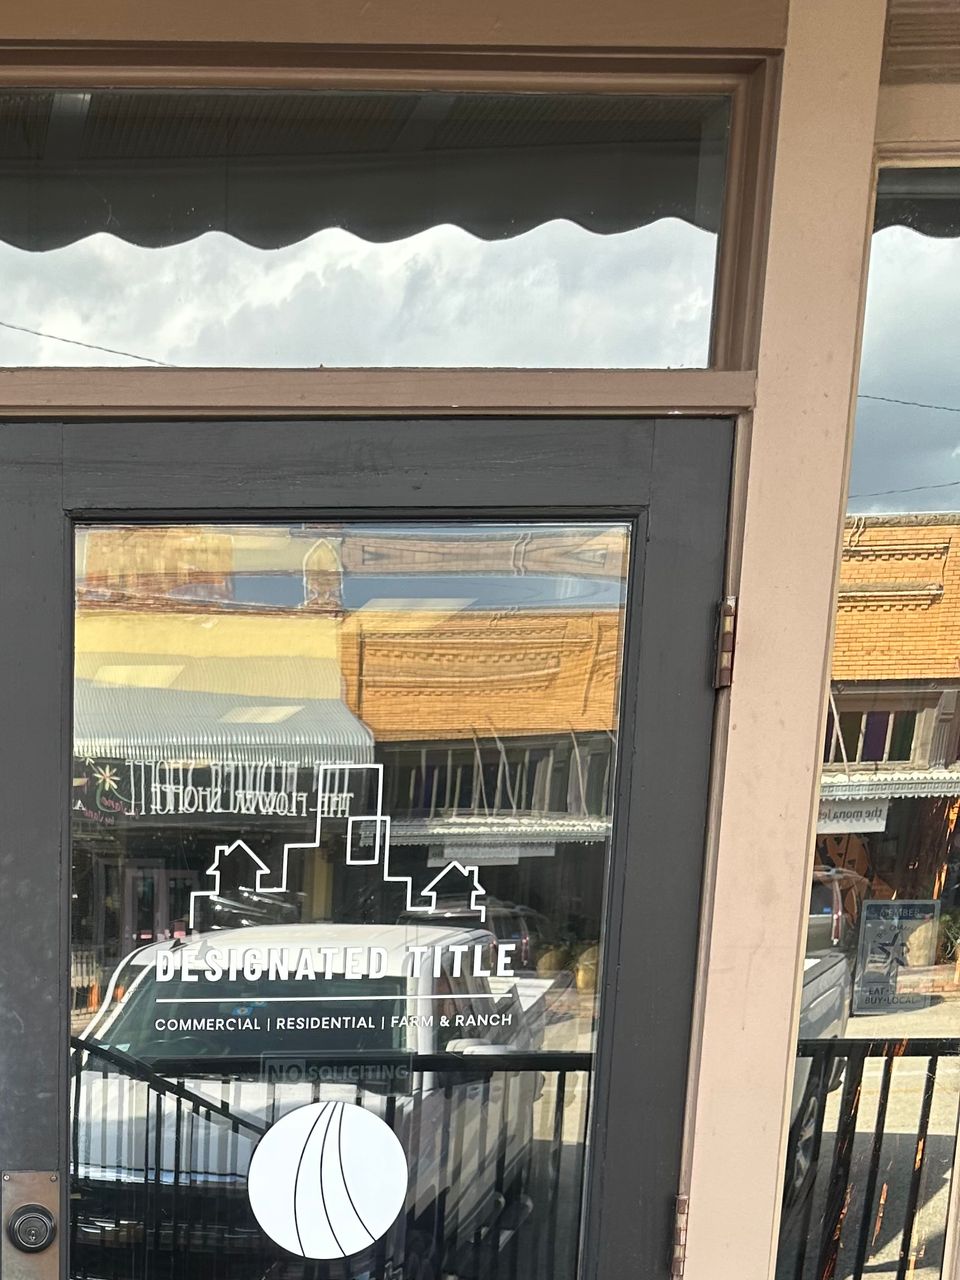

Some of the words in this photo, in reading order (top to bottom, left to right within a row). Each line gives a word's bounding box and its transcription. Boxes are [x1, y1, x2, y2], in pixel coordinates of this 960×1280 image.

[155, 946, 389, 982] DESIGNATED
[407, 943, 516, 979] TITLE
[155, 1018, 261, 1032] COMMERCIAL
[276, 1016, 376, 1030] RESIDENTIAL
[391, 1015, 434, 1029] FARM
[439, 1015, 451, 1028] &
[455, 1013, 513, 1027] RANCH
[268, 1063, 304, 1082] NO
[308, 1064, 409, 1081] SOLICITING
